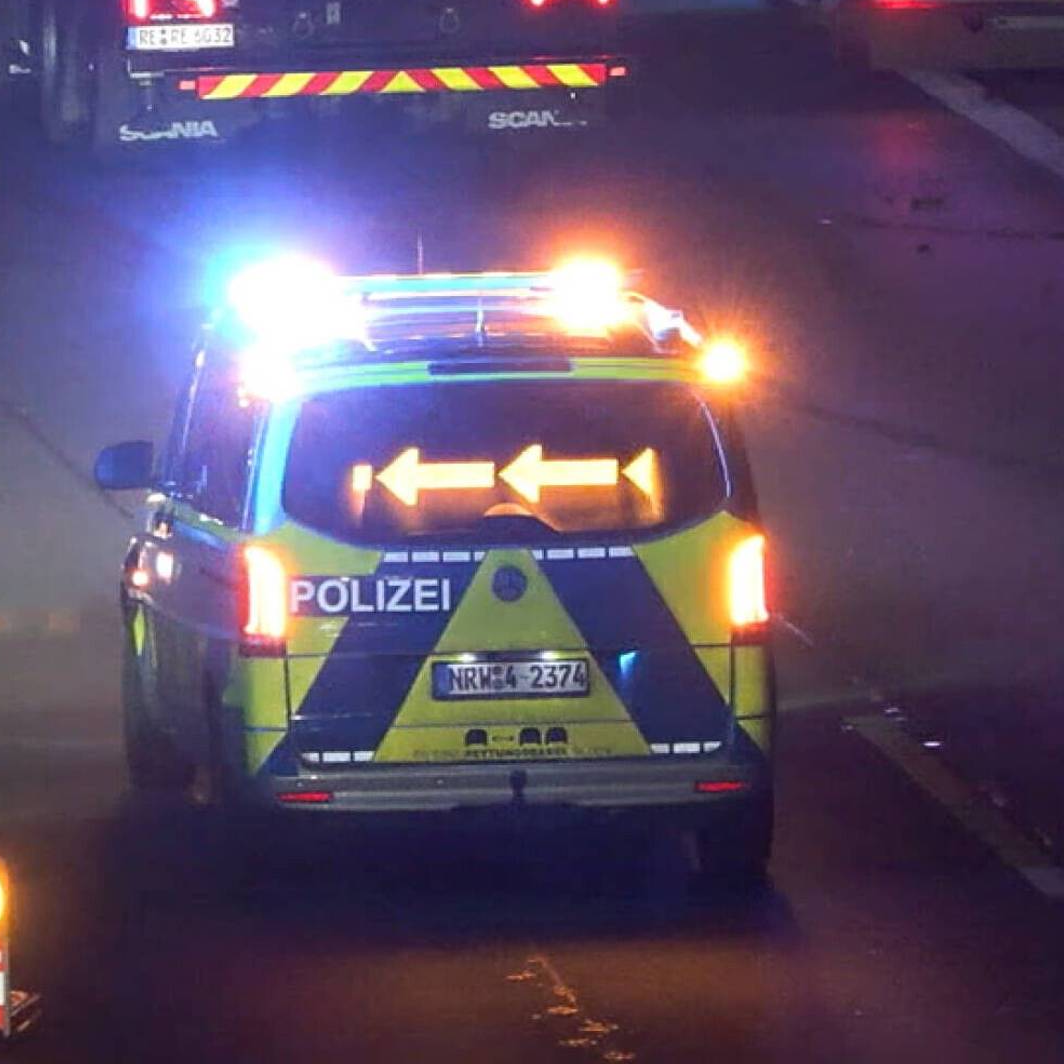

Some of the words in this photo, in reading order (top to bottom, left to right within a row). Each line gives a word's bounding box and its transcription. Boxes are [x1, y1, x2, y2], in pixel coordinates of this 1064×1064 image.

[119, 120, 218, 141] SNIA
[488, 110, 588, 129] SCAN
[290, 578, 452, 614] POLIZEI
[449, 666, 492, 690] NRW
